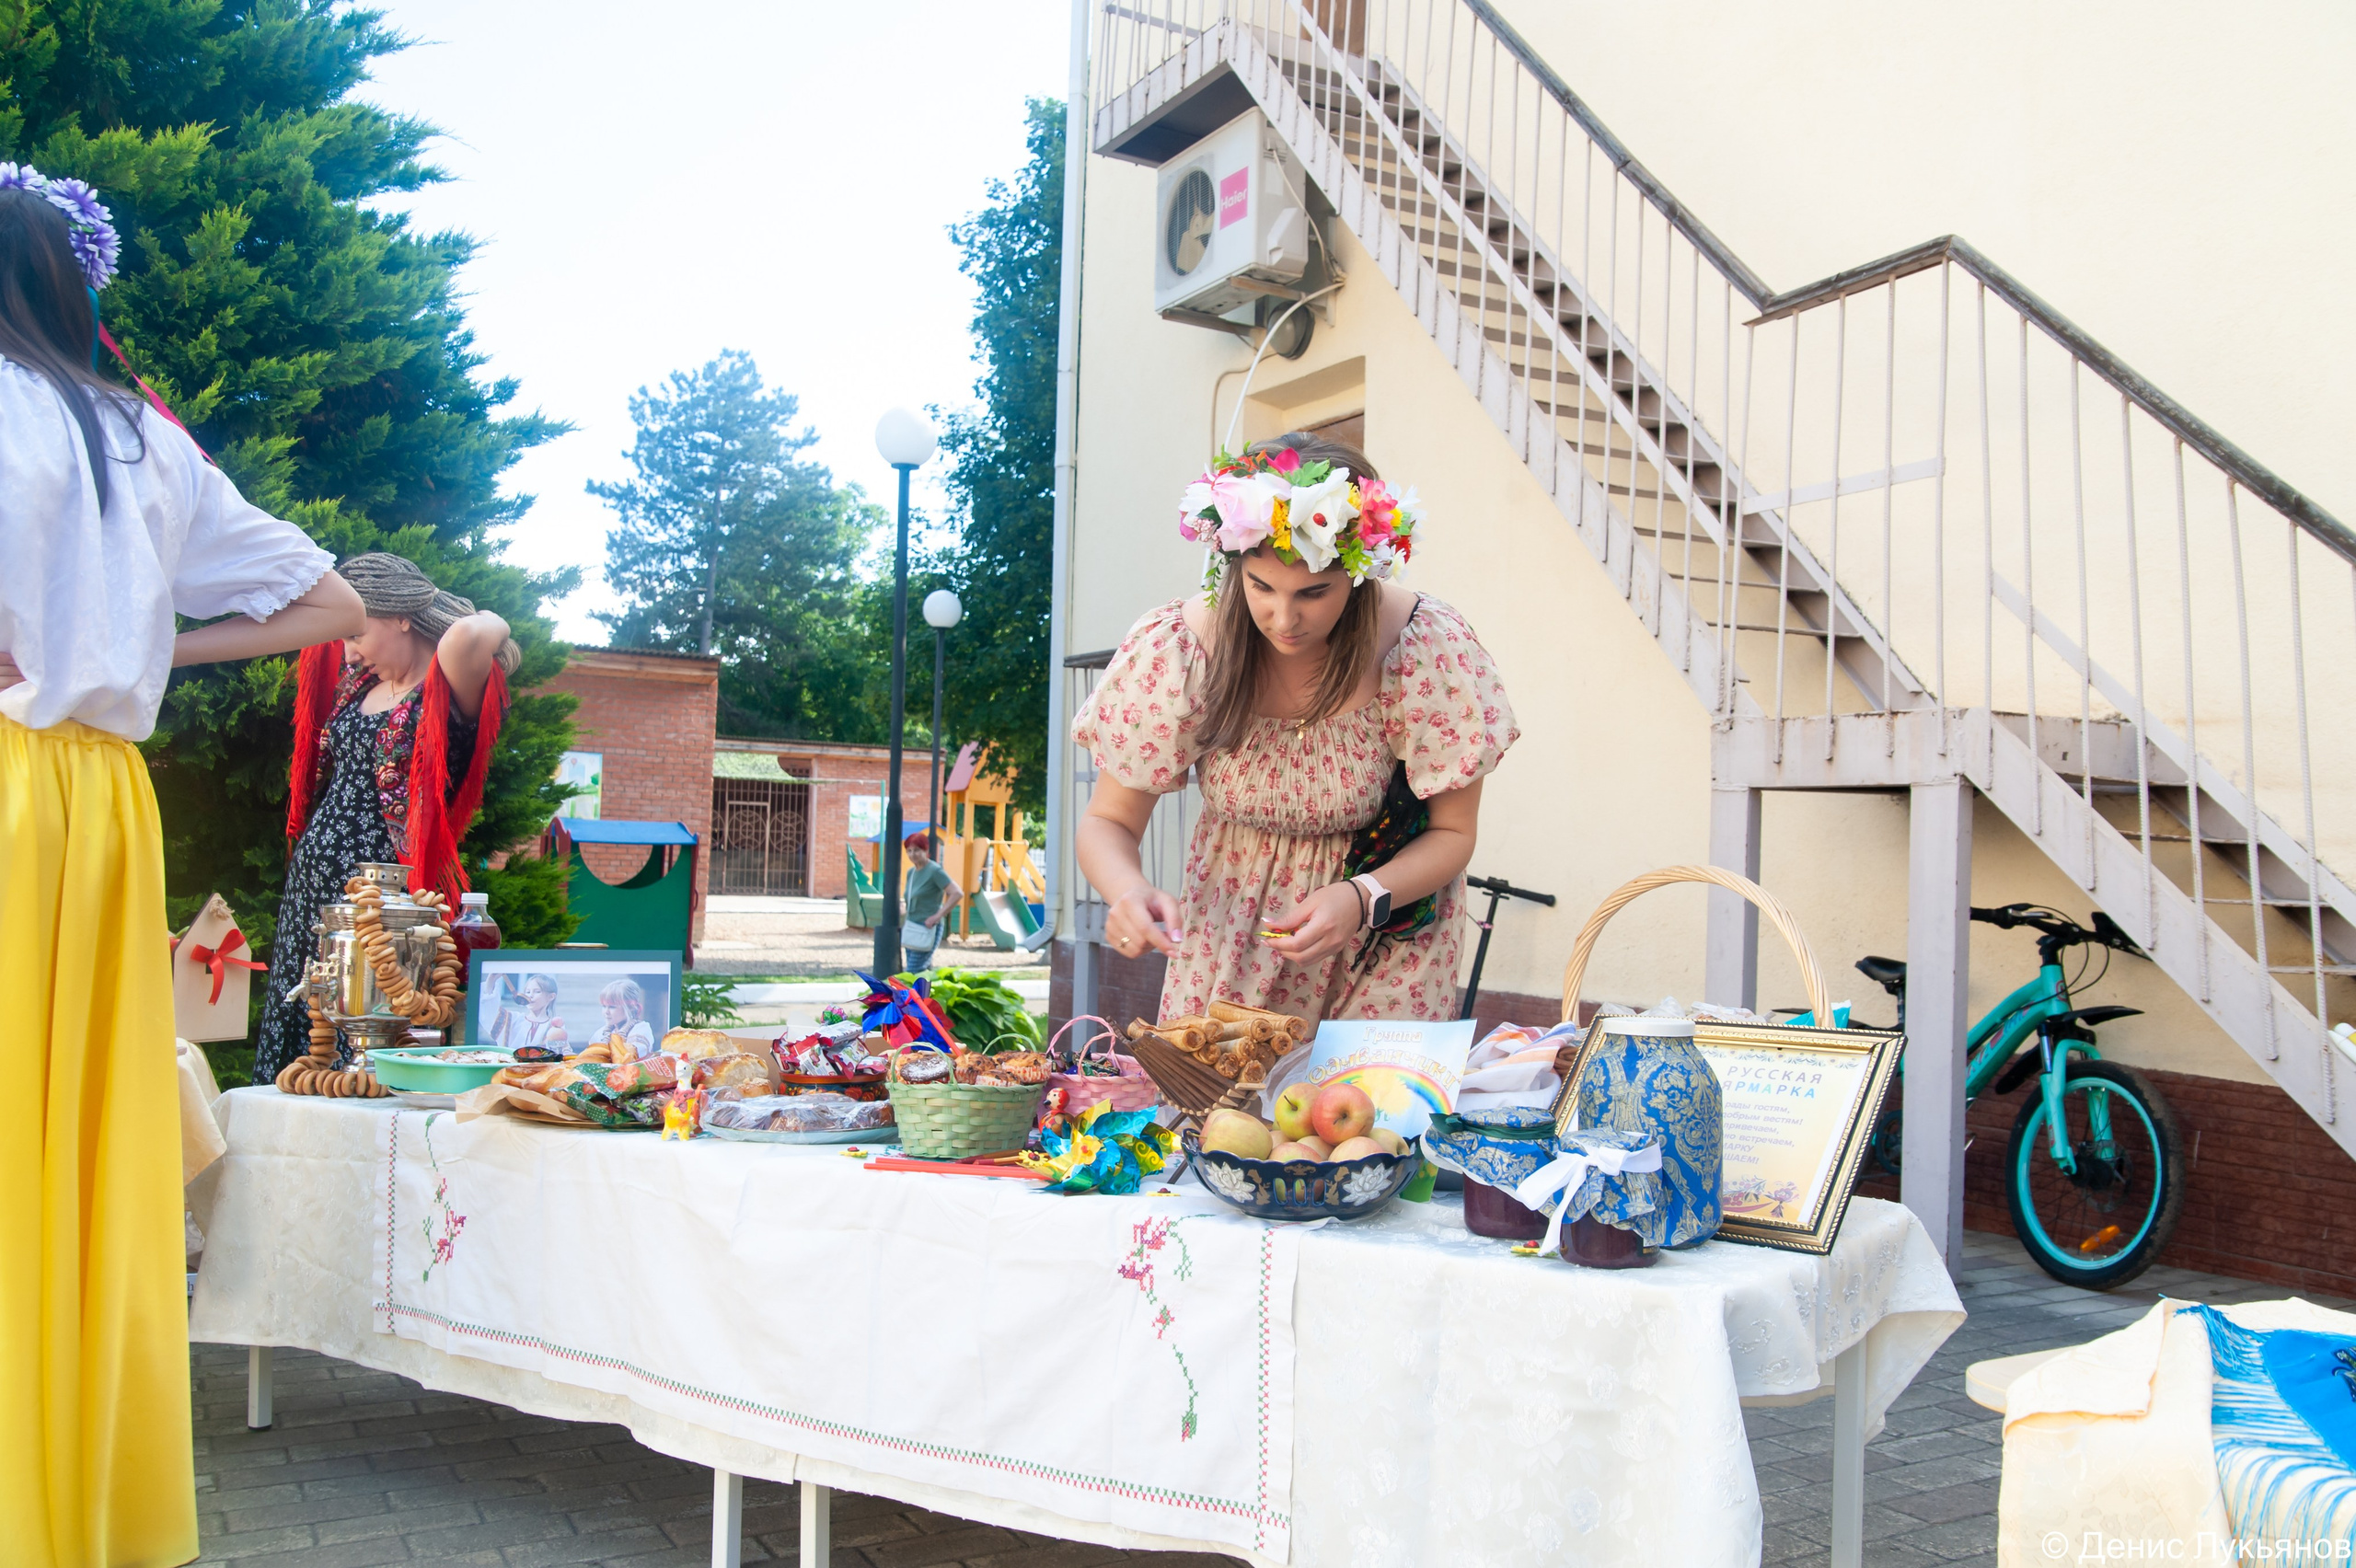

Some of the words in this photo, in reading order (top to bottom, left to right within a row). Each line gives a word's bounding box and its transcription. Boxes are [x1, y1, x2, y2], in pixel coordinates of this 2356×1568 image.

[1220, 188, 1248, 211] Haier
[1363, 1026, 1423, 1044] Группа
[1727, 1066, 1822, 1084] РУССКАЯ
[1722, 1080, 1815, 1099] ЯРМАРКА
[1725, 1101, 1750, 1110] рады
[1754, 1104, 1790, 1113] гостям,
[1763, 1115, 1803, 1125] вестям!
[1738, 1135, 1795, 1147] встречаем,
